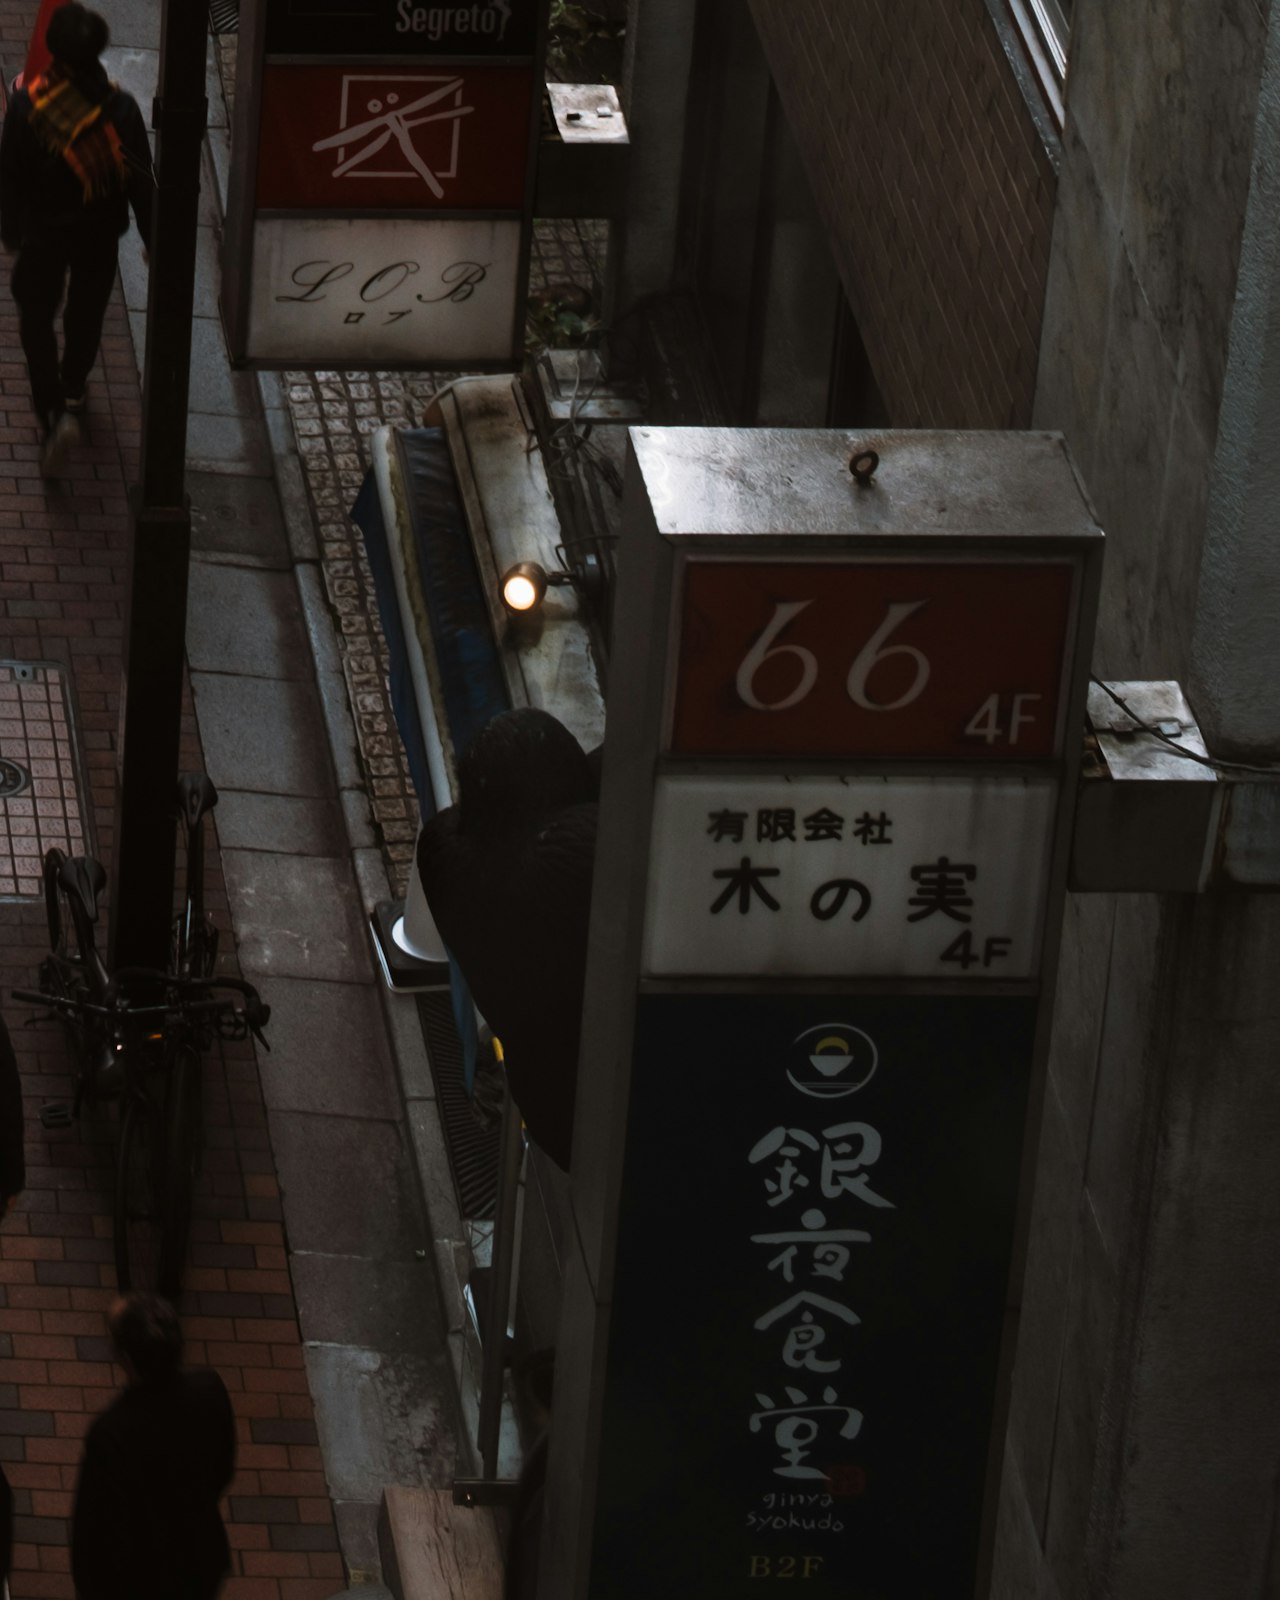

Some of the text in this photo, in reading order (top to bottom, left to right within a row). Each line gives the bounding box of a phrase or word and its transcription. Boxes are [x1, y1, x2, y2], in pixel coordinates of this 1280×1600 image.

[735, 599, 931, 711] 66
[964, 692, 1043, 746] 4F
[706, 807, 894, 846] 有限会社
[709, 856, 977, 923] 木の実
[940, 930, 1013, 968] 4F
[747, 1121, 897, 1479] 銀夜食堂
[762, 1490, 834, 1509] ginya
[745, 1509, 845, 1532] syokudo
[748, 1554, 825, 1579] B2F
